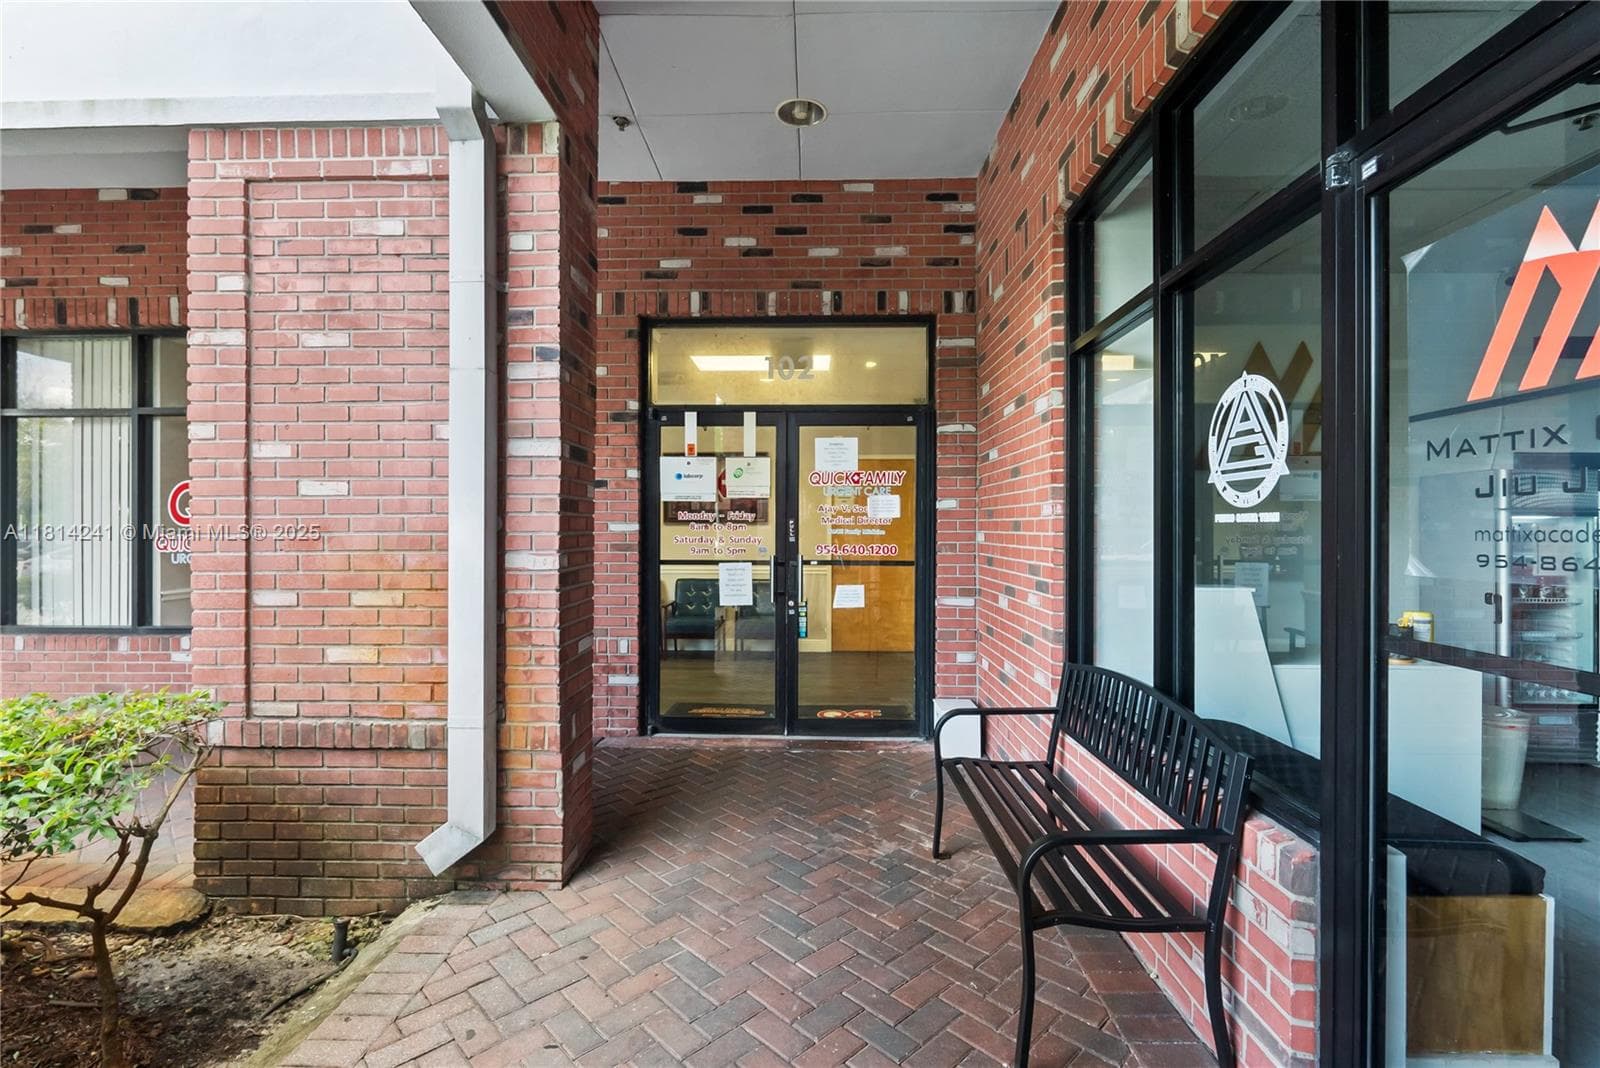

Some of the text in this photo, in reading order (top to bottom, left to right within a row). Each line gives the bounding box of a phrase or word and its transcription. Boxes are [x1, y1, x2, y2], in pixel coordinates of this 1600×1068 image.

[765, 356, 816, 381] 102
[1426, 423, 1569, 461] MATTIX
[808, 470, 906, 486] QUICK FAMILY
[863, 486, 892, 496] CARE
[1475, 475, 1536, 498] JIU
[817, 504, 838, 515] Ajay
[677, 511, 716, 522] Monday
[727, 511, 756, 522] Friday
[821, 516, 892, 525] Medical Director
[689, 522, 747, 532] 8am to 8pm
[673, 535, 715, 546] Saturday
[728, 535, 763, 546] Sunday
[690, 546, 710, 555] 9am
[713, 547, 723, 555] to
[727, 546, 747, 556] 5pm
[815, 544, 898, 556] 954.640.1200
[1476, 554, 1600, 572] 954-864
